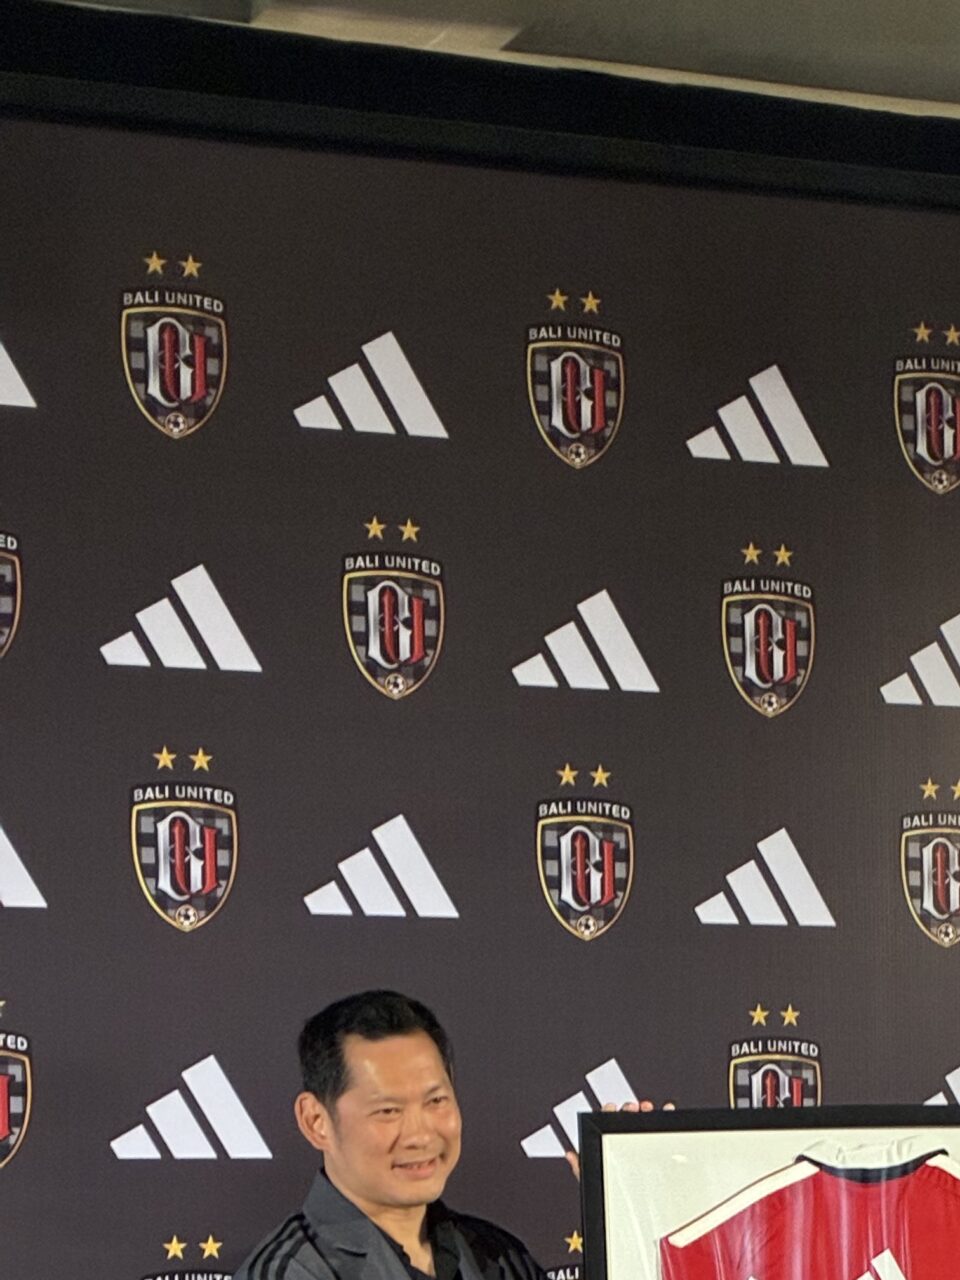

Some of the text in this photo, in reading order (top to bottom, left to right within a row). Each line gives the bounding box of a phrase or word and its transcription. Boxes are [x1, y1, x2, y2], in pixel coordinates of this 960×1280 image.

[123, 290, 224, 313] BALI UNITED
[529, 325, 621, 347] BALI UNITED
[896, 357, 926, 371] BALI
[345, 555, 440, 576] BALI UNITED
[723, 579, 812, 598] BALI UNITED
[133, 785, 234, 805] BALI UNITED
[538, 800, 630, 820] BALI UNITED
[902, 814, 933, 829] BALI
[731, 1039, 819, 1057] BALI UNITED
